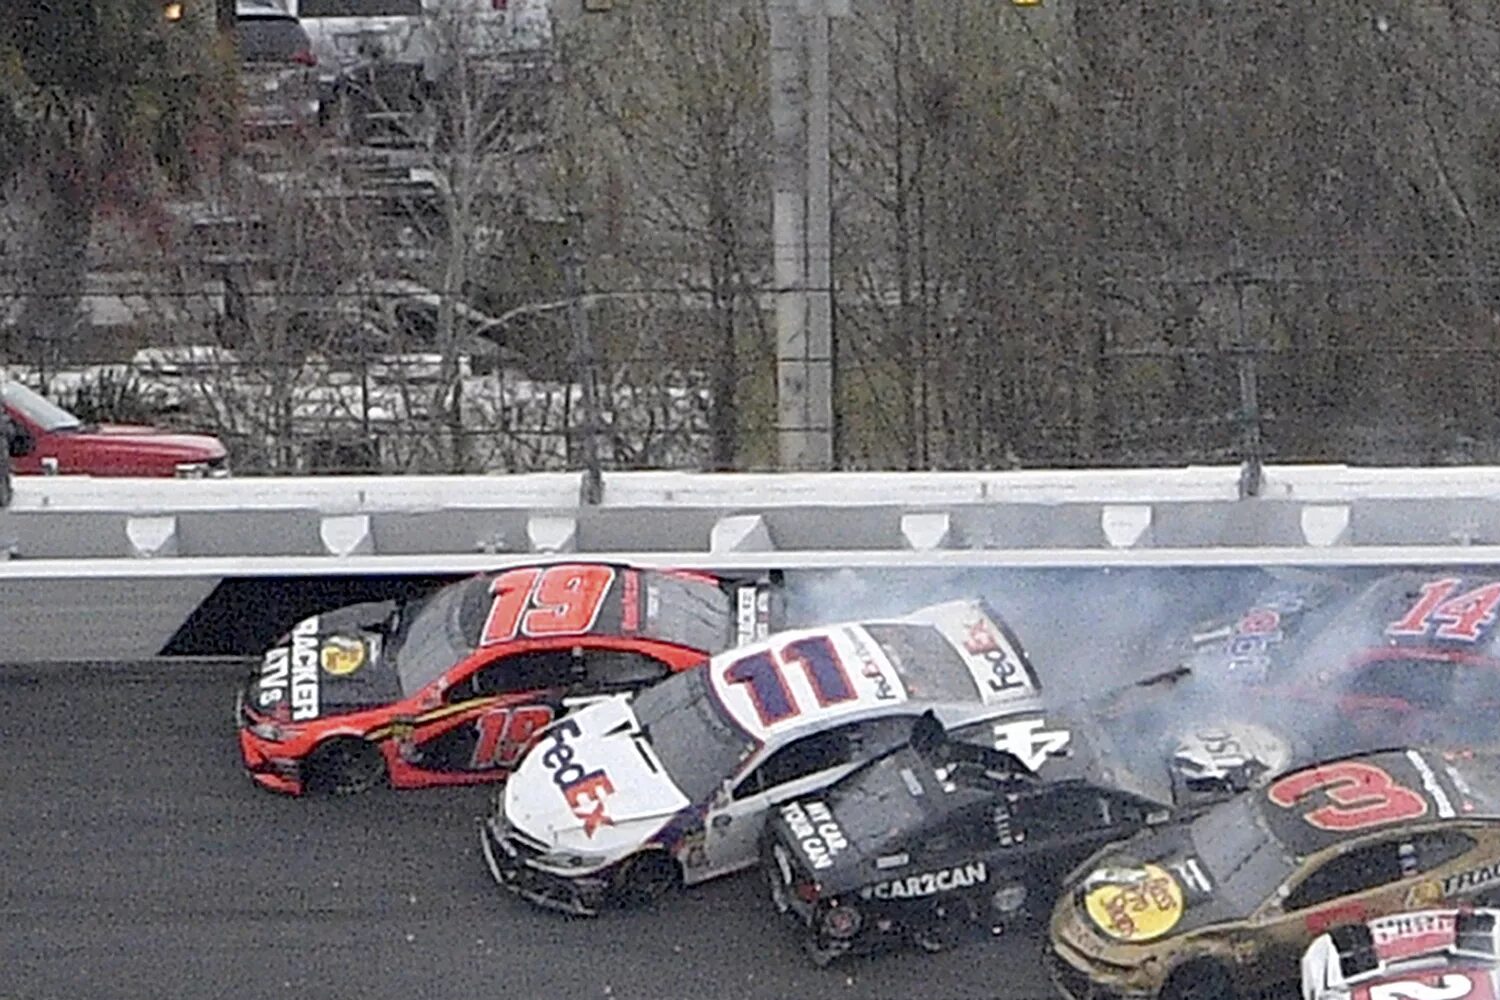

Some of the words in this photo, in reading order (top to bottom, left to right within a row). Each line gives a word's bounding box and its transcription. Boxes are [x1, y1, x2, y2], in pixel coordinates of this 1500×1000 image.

[481, 564, 615, 646] 19
[291, 615, 320, 720] RACKER
[722, 634, 859, 729] 11
[542, 718, 616, 840] FedEx
[991, 717, 1073, 772] 4
[1267, 760, 1427, 832] 3
[802, 838, 834, 870] CAN
